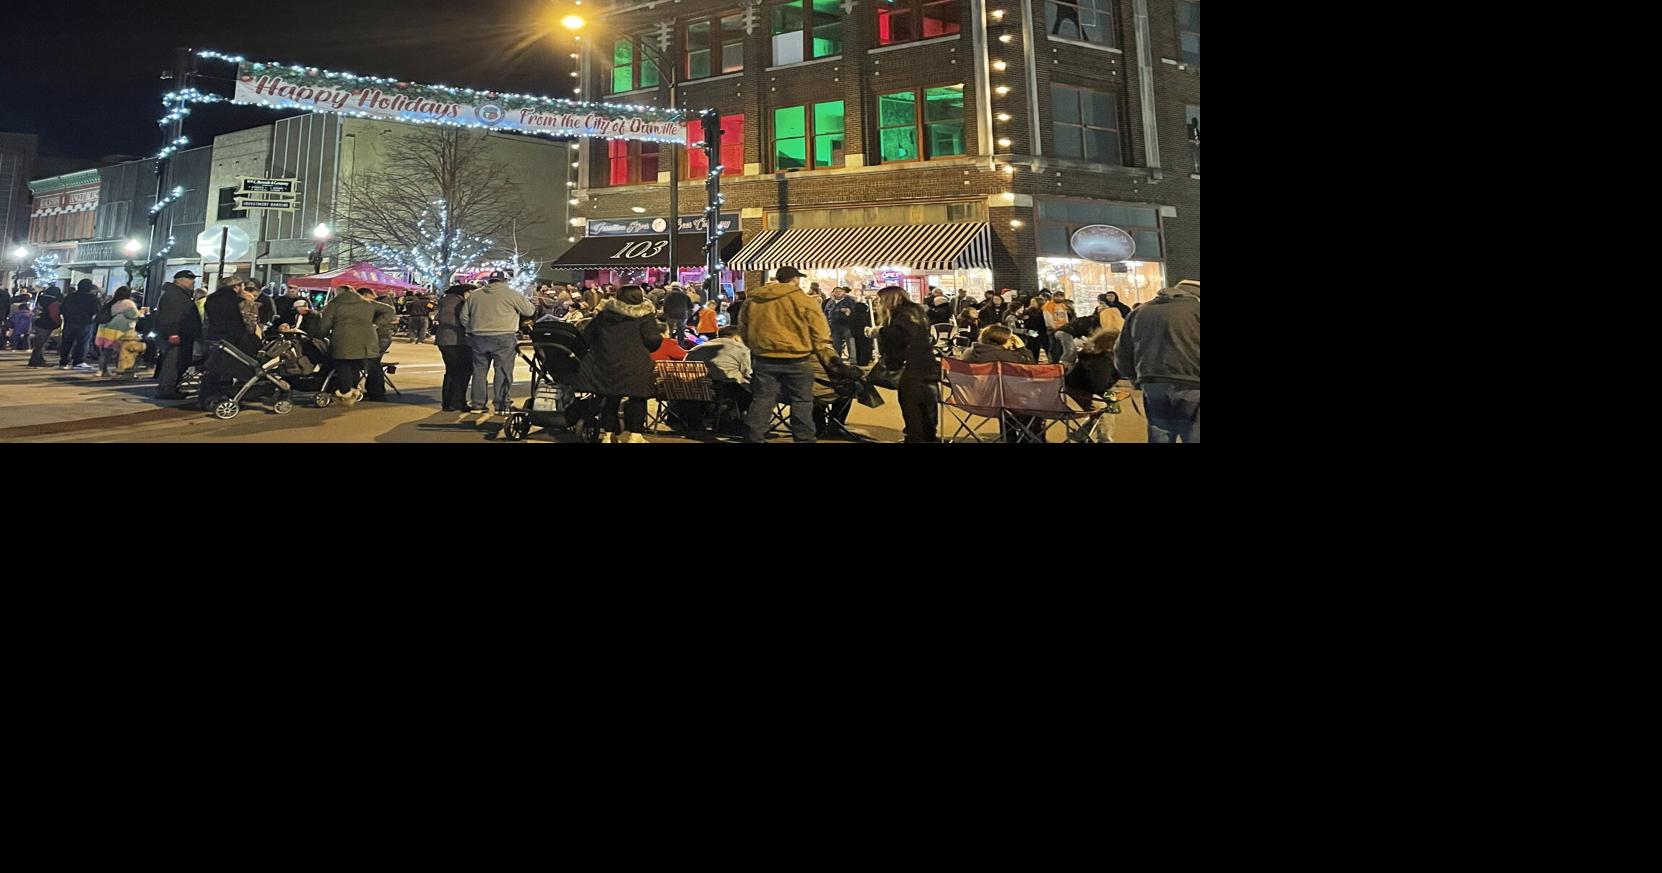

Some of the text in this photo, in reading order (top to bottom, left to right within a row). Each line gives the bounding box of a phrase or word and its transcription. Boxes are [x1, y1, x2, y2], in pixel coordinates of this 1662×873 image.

[256, 75, 460, 118] Happy Holidays
[520, 108, 678, 136] From the City of Danville
[610, 240, 669, 259] 103
